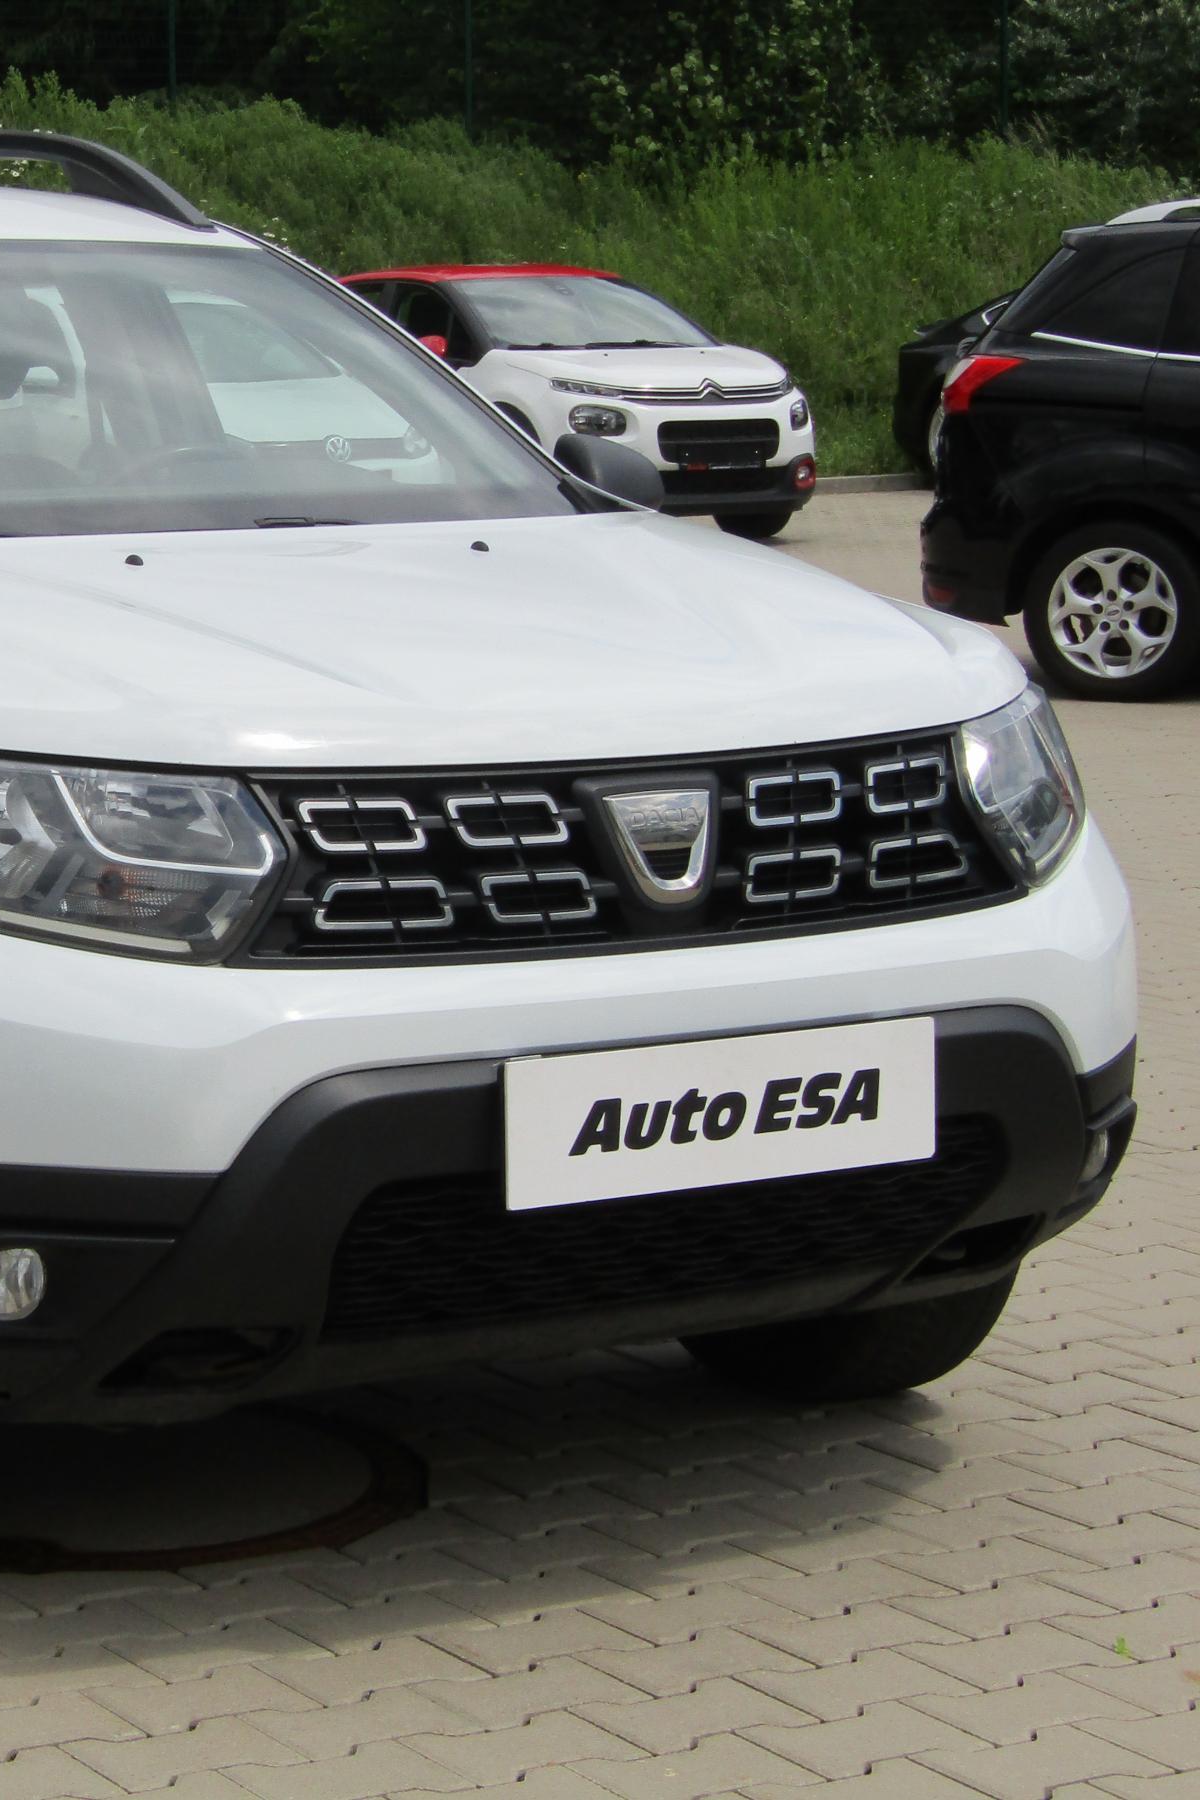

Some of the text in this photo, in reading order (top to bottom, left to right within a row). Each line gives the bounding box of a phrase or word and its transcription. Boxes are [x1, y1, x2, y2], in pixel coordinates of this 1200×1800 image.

[629, 806, 701, 828] DACIA
[568, 1068, 881, 1156] Auto ESA
